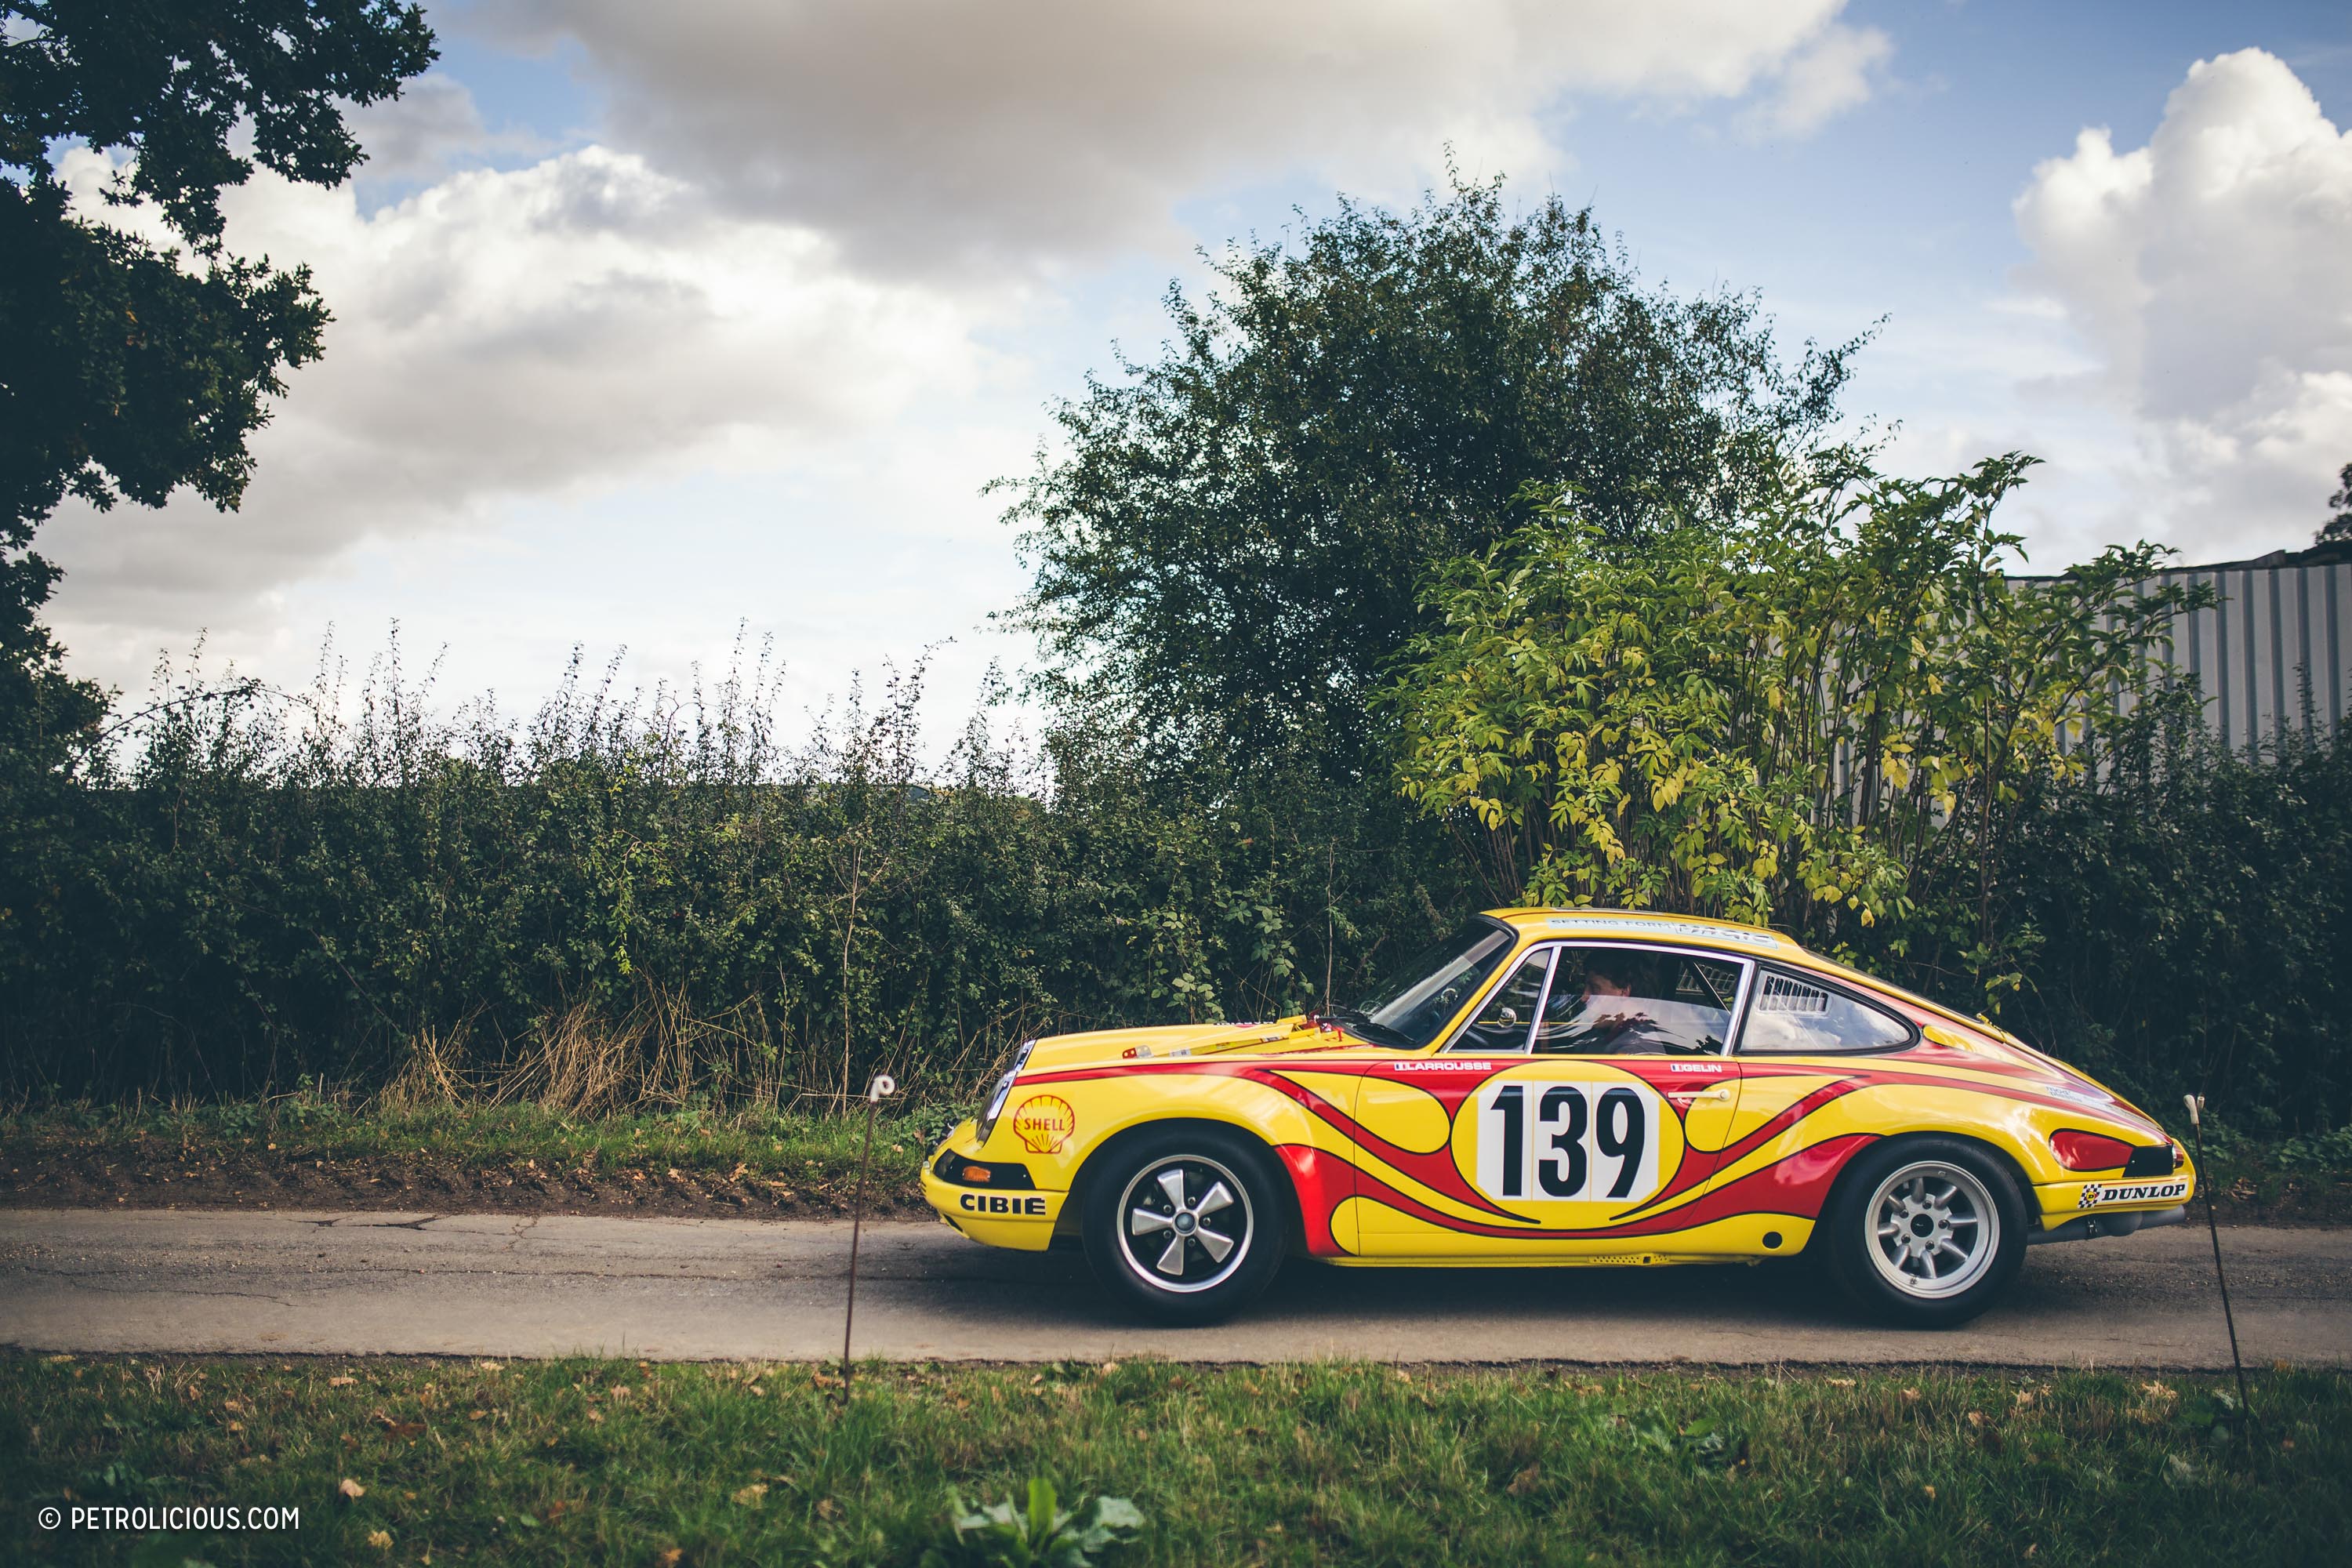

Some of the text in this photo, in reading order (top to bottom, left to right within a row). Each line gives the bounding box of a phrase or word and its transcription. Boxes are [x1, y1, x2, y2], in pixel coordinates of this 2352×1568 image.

[1406, 1062, 1492, 1071] LARROUSSE
[1683, 1064, 1722, 1073] GELIN
[1024, 1118, 1065, 1131] SHELL
[1490, 1085, 1645, 1199] 139
[2102, 1184, 2185, 1200] DUNLOP
